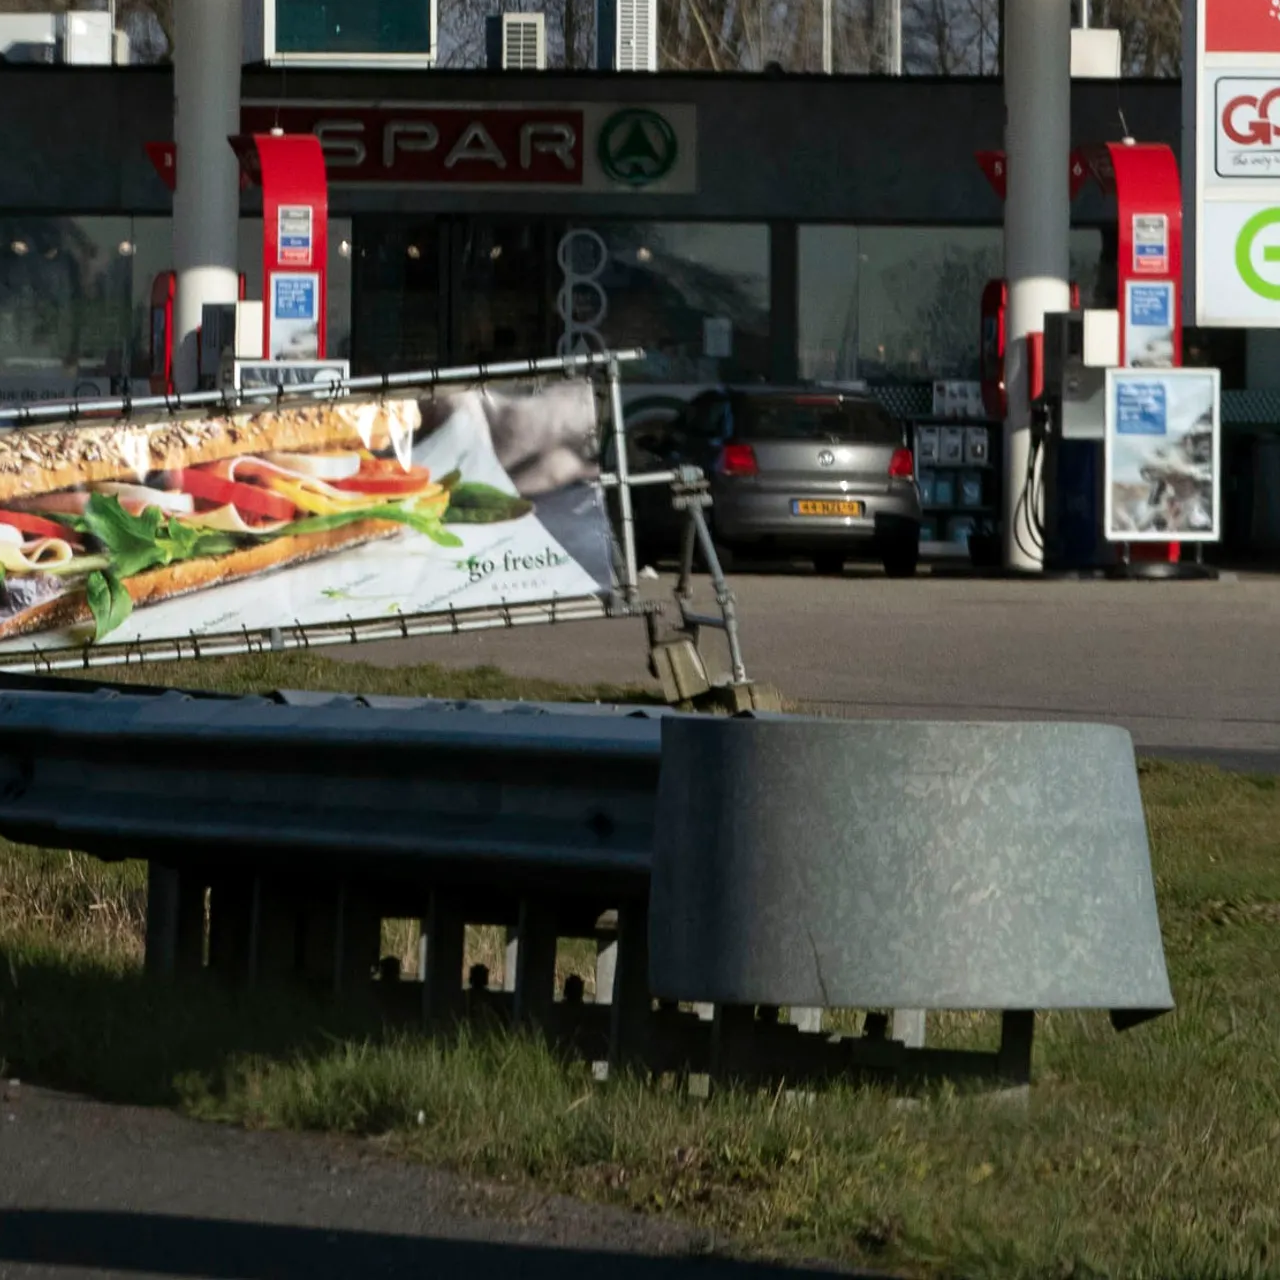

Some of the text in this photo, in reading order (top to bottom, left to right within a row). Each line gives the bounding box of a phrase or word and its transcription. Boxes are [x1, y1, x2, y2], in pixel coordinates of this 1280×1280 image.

[314, 120, 576, 171] SPAR
[467, 547, 561, 581] go fresh
